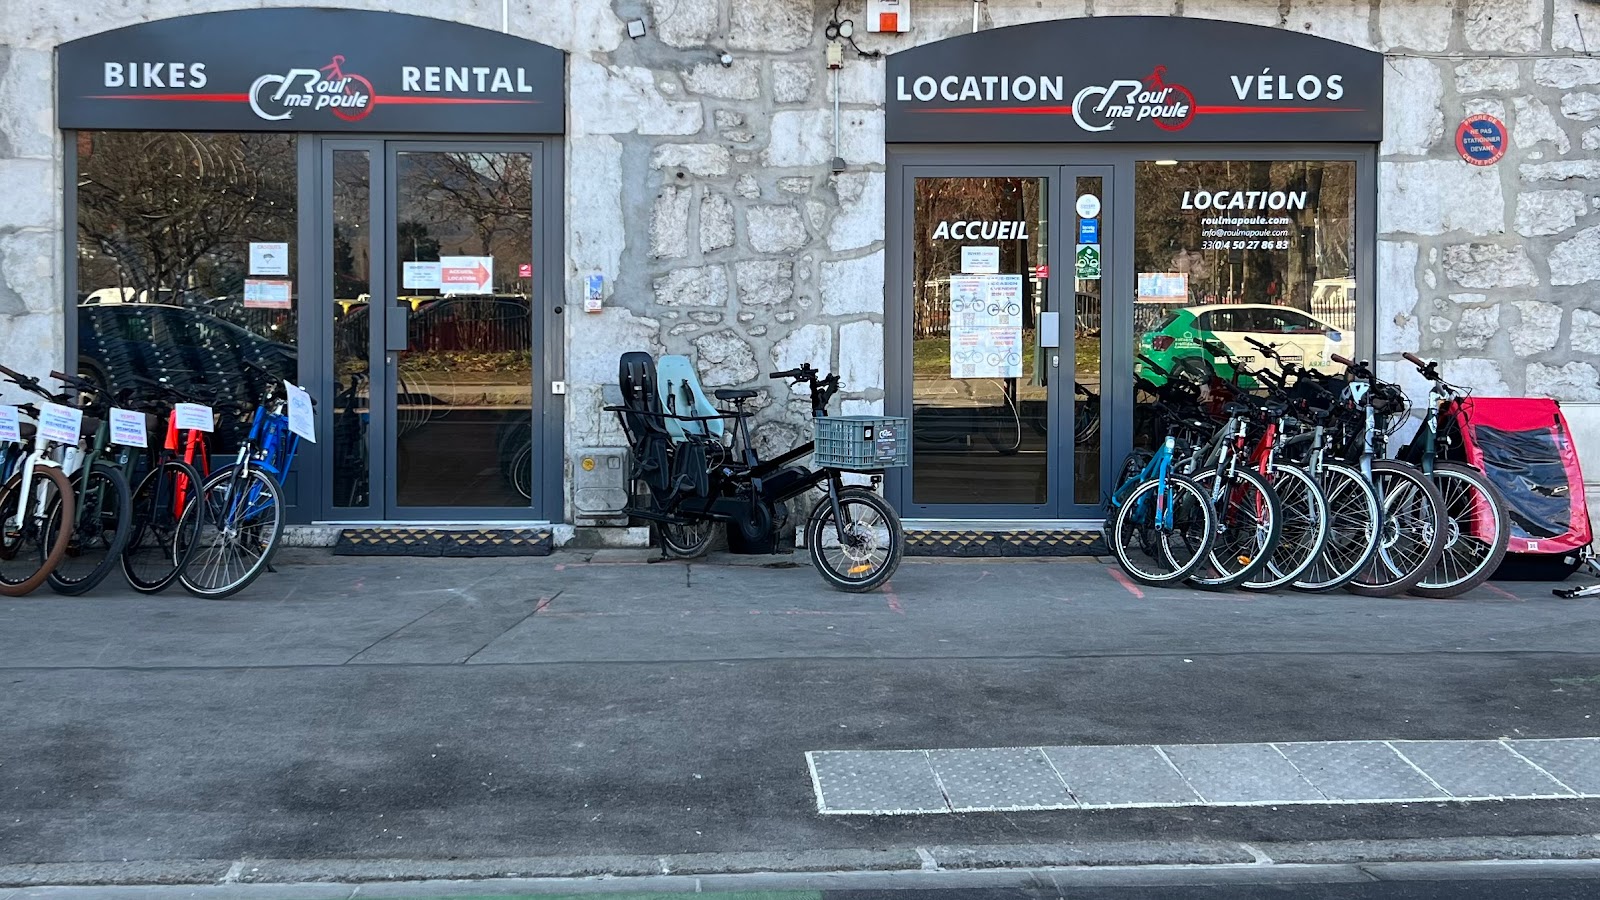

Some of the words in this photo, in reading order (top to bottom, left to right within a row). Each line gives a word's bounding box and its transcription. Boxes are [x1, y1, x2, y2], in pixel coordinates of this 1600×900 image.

[104, 62, 207, 89] BIKES
[402, 66, 533, 93] RENTAL
[1230, 67, 1344, 101] VÉLOS
[897, 75, 1064, 102] LOCATION
[283, 94, 314, 107] ma
[314, 91, 368, 111] poule
[1105, 105, 1135, 118] ma
[1136, 102, 1189, 121] poule
[1463, 136, 1501, 144] STATIONNER
[1462, 153, 1482, 165] CETTE
[1180, 190, 1307, 210] LOCATION
[931, 220, 1029, 240] ACCUEIL
[1201, 216, 1289, 227] roulmapoule.com
[1201, 228, 1288, 238] info@roulmapoule.com
[1232, 240, 1246, 250] 50
[1246, 240, 1260, 250] 27
[1261, 240, 1274, 250] 86
[1275, 240, 1289, 250] 83
